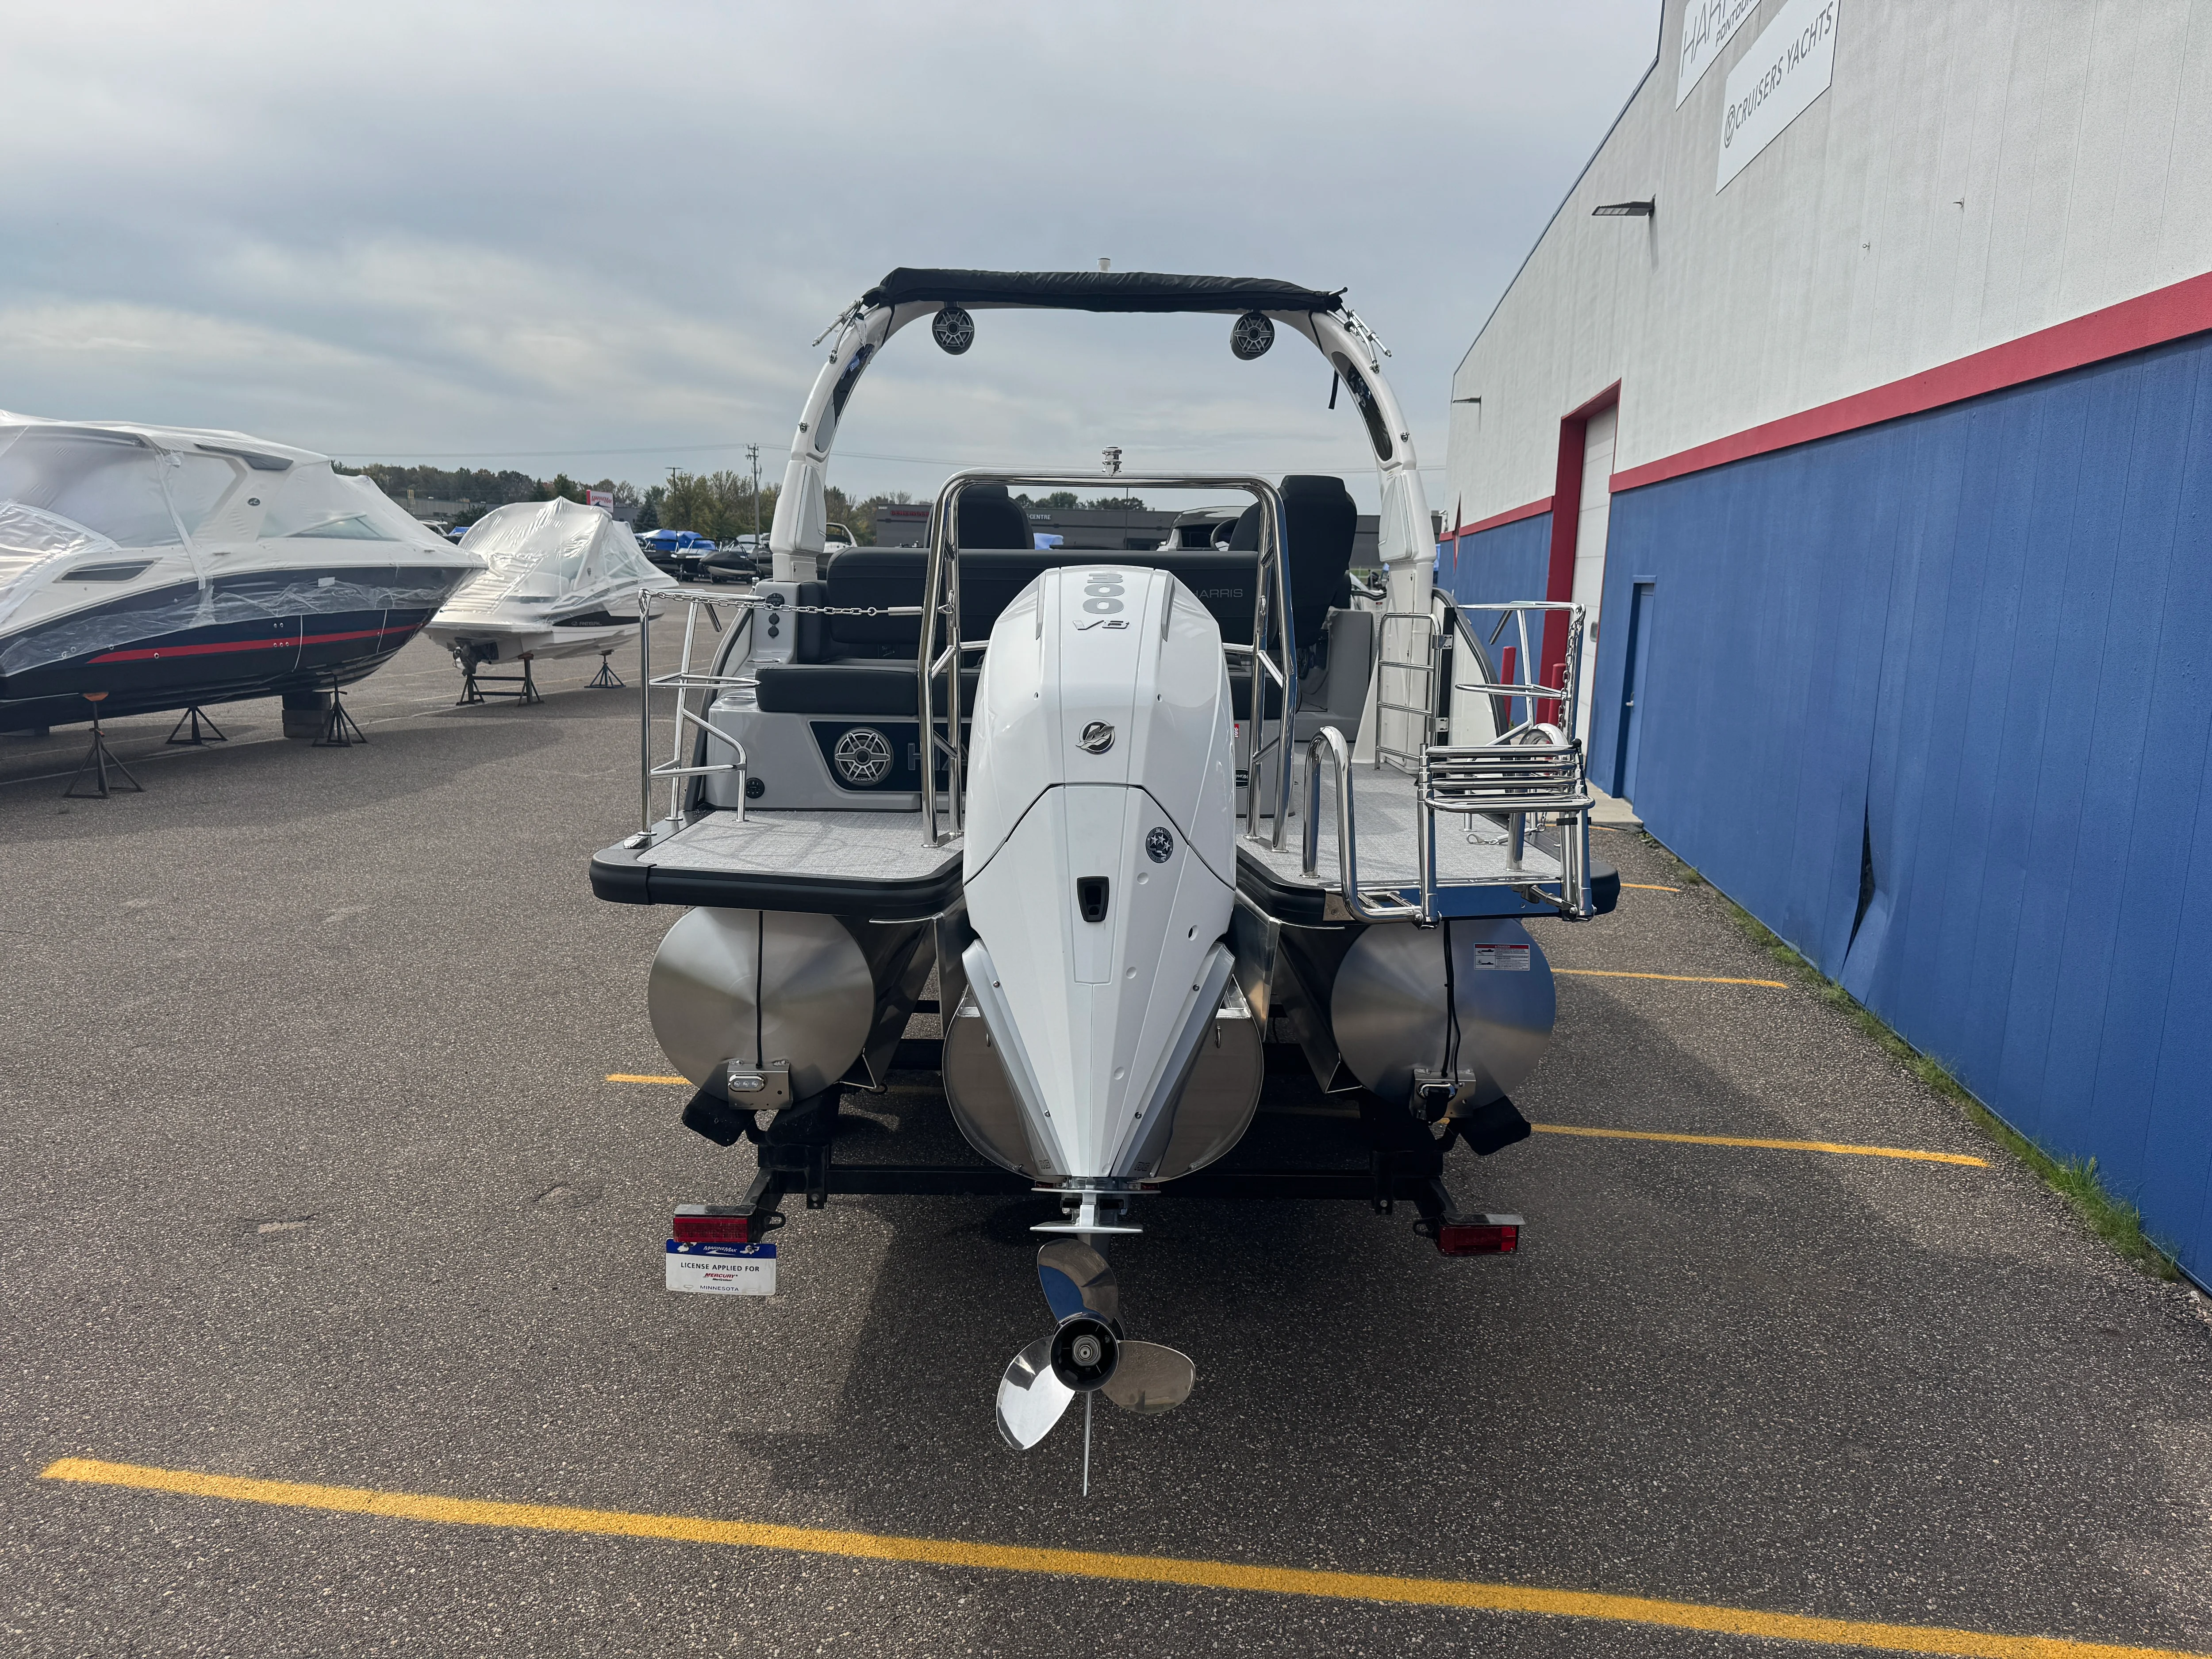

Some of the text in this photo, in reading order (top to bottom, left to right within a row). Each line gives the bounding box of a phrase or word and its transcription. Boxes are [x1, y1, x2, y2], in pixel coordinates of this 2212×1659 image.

[1715, 0, 1751, 47] PONTOO
[1736, 55, 1783, 129] CRUISERS
[1787, 1, 1833, 74] YACHTS
[1083, 573, 1125, 614] 300
